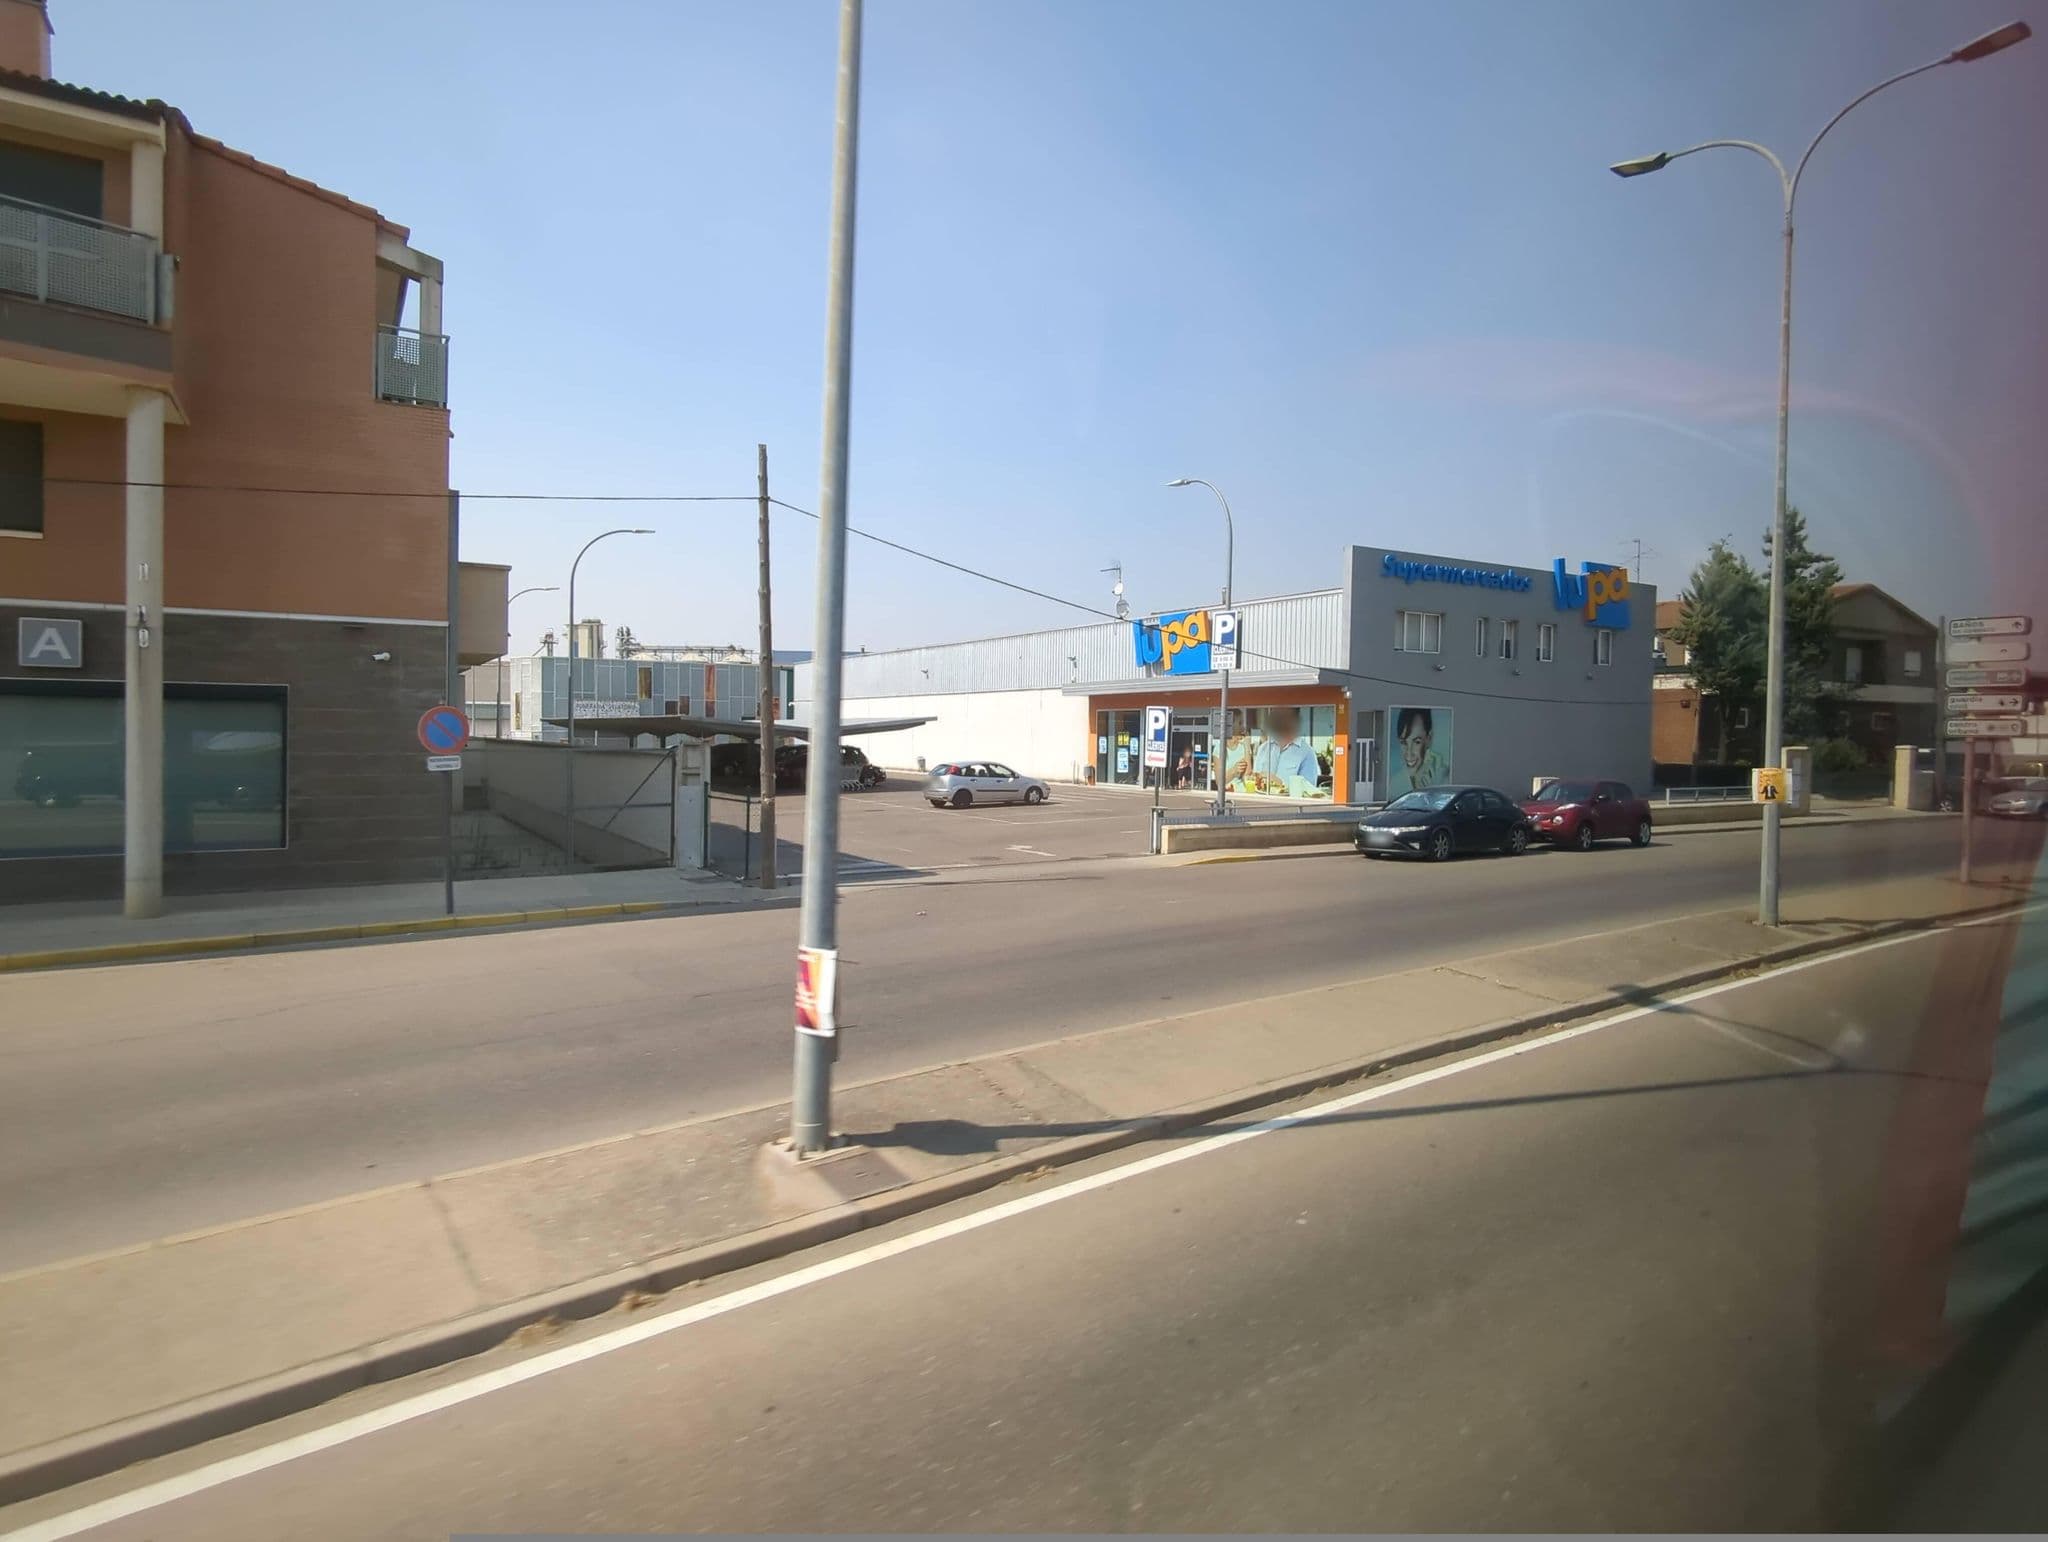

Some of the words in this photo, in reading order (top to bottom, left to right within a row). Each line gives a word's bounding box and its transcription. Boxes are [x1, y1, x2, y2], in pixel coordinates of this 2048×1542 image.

[1380, 552, 1532, 593] Supermercados
[1553, 556, 1630, 621] lupa
[28, 627, 72, 659] A
[1133, 610, 1209, 672] lupa
[1215, 613, 1235, 645] P
[1148, 709, 1166, 740] P
